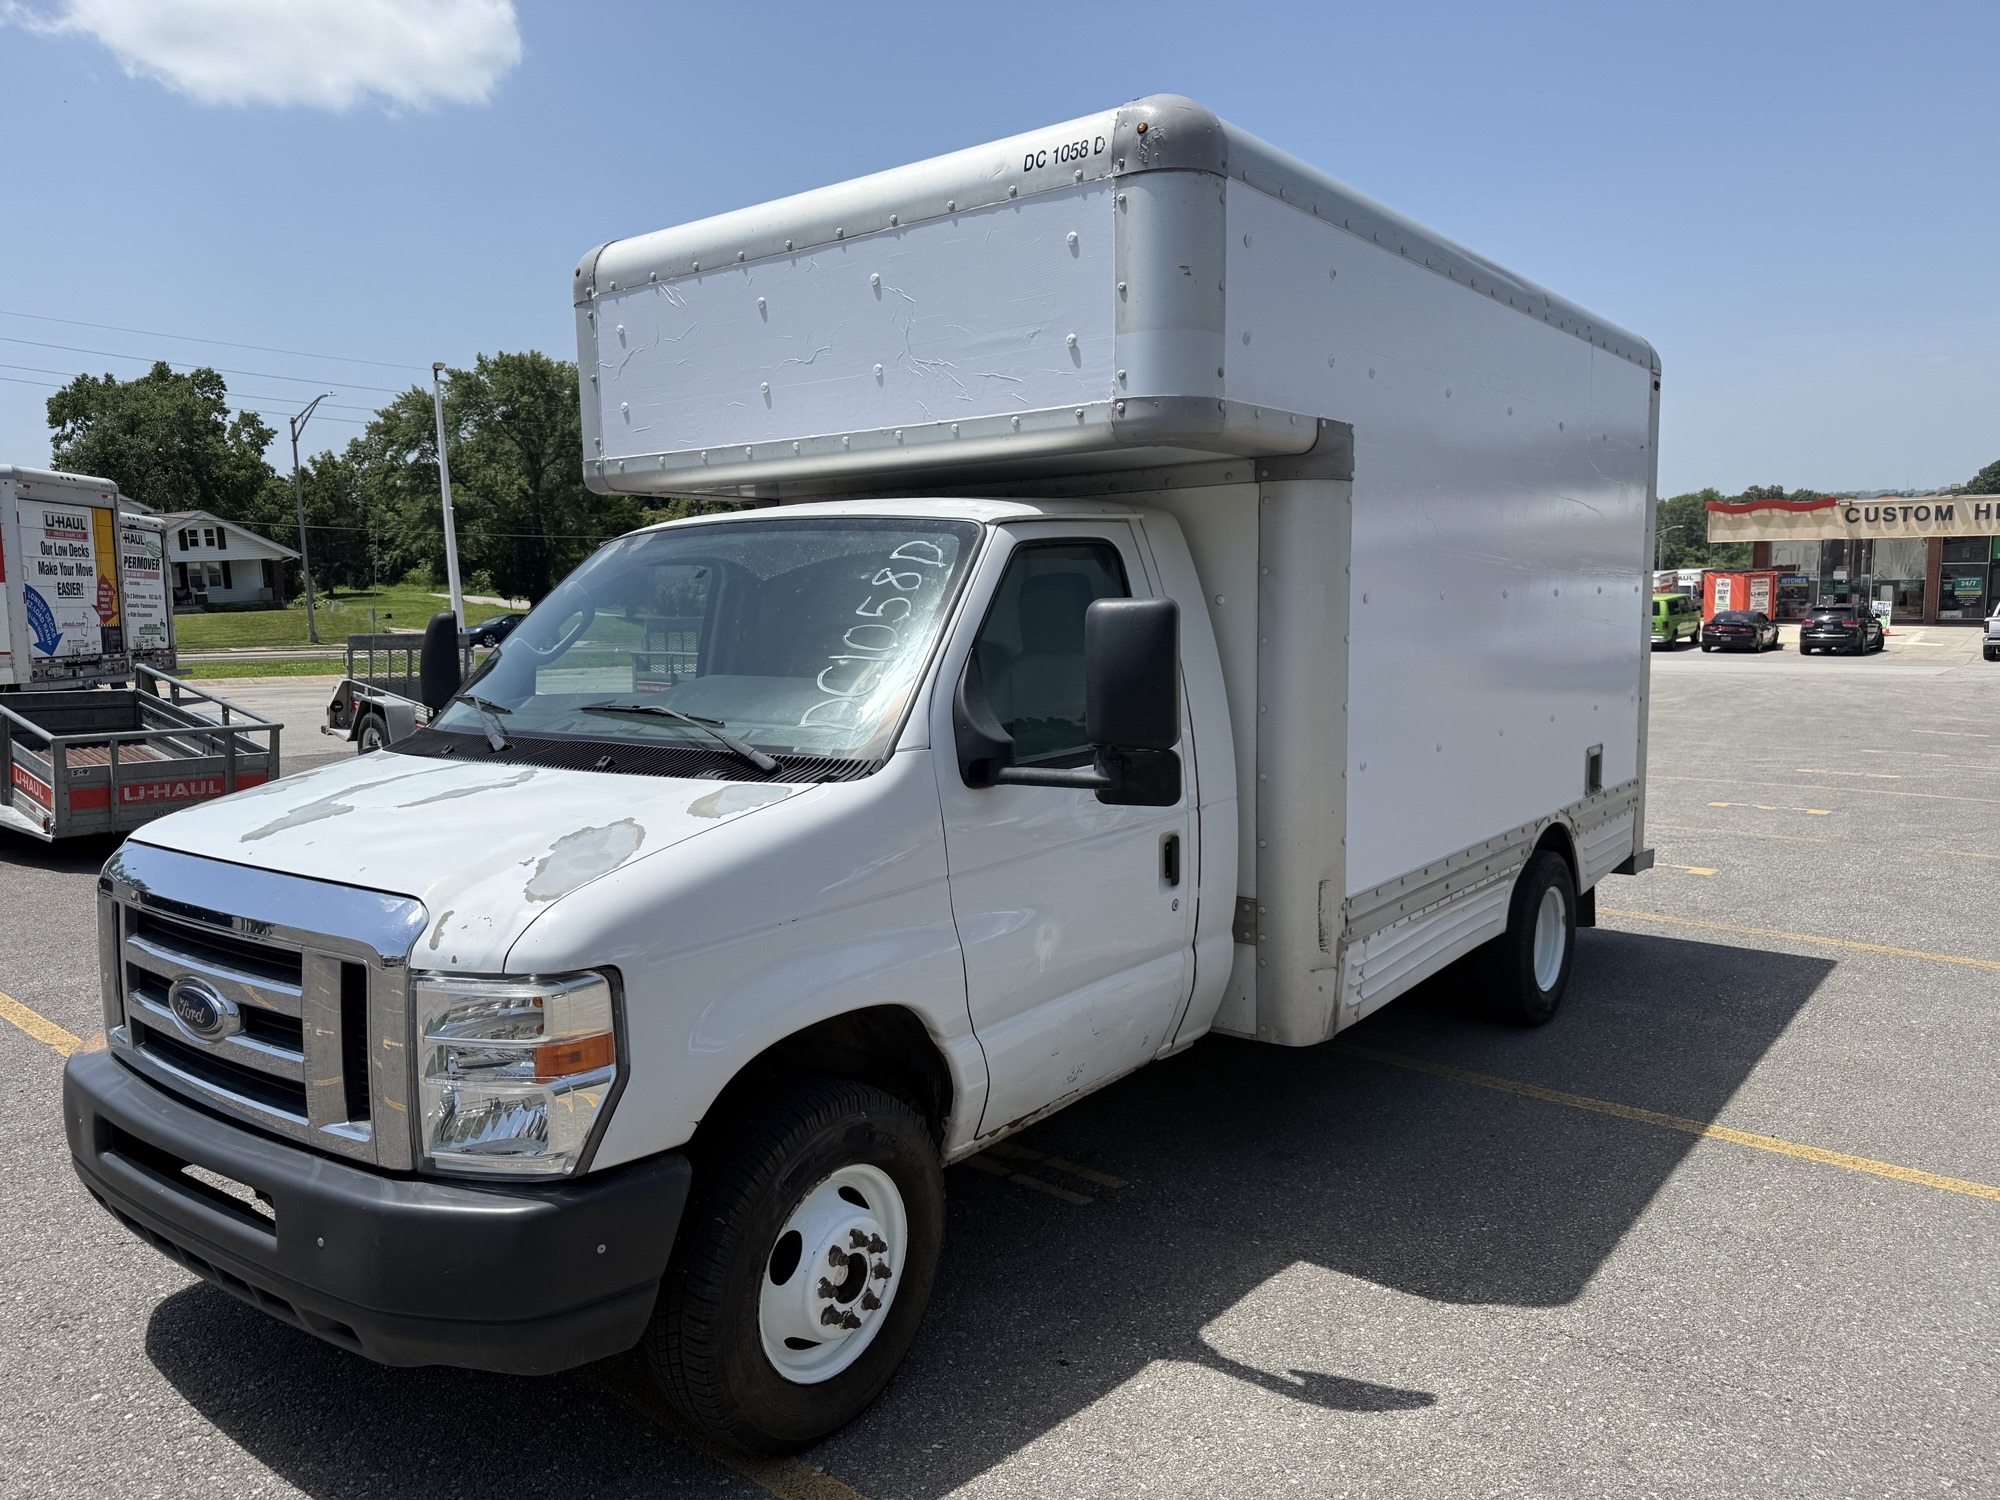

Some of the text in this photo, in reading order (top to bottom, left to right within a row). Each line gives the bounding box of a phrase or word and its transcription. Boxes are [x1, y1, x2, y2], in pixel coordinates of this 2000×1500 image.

[1024, 135, 1106, 173] DC 1058 D
[45, 514, 87, 531] U-HAUL
[1844, 504, 1955, 524] CUSTOM
[40, 540, 90, 558] Our Low Decks
[123, 533, 145, 546] -HAUL
[37, 561, 94, 577] Make Your Move
[124, 556, 160, 571] PERMOVER
[57, 582, 84, 596] EASIER!
[27, 591, 57, 639] LOWEST DECKS
[15, 769, 44, 800] U-HAUL
[123, 780, 222, 801] U-HAUL
[177, 997, 206, 1024] Ford
